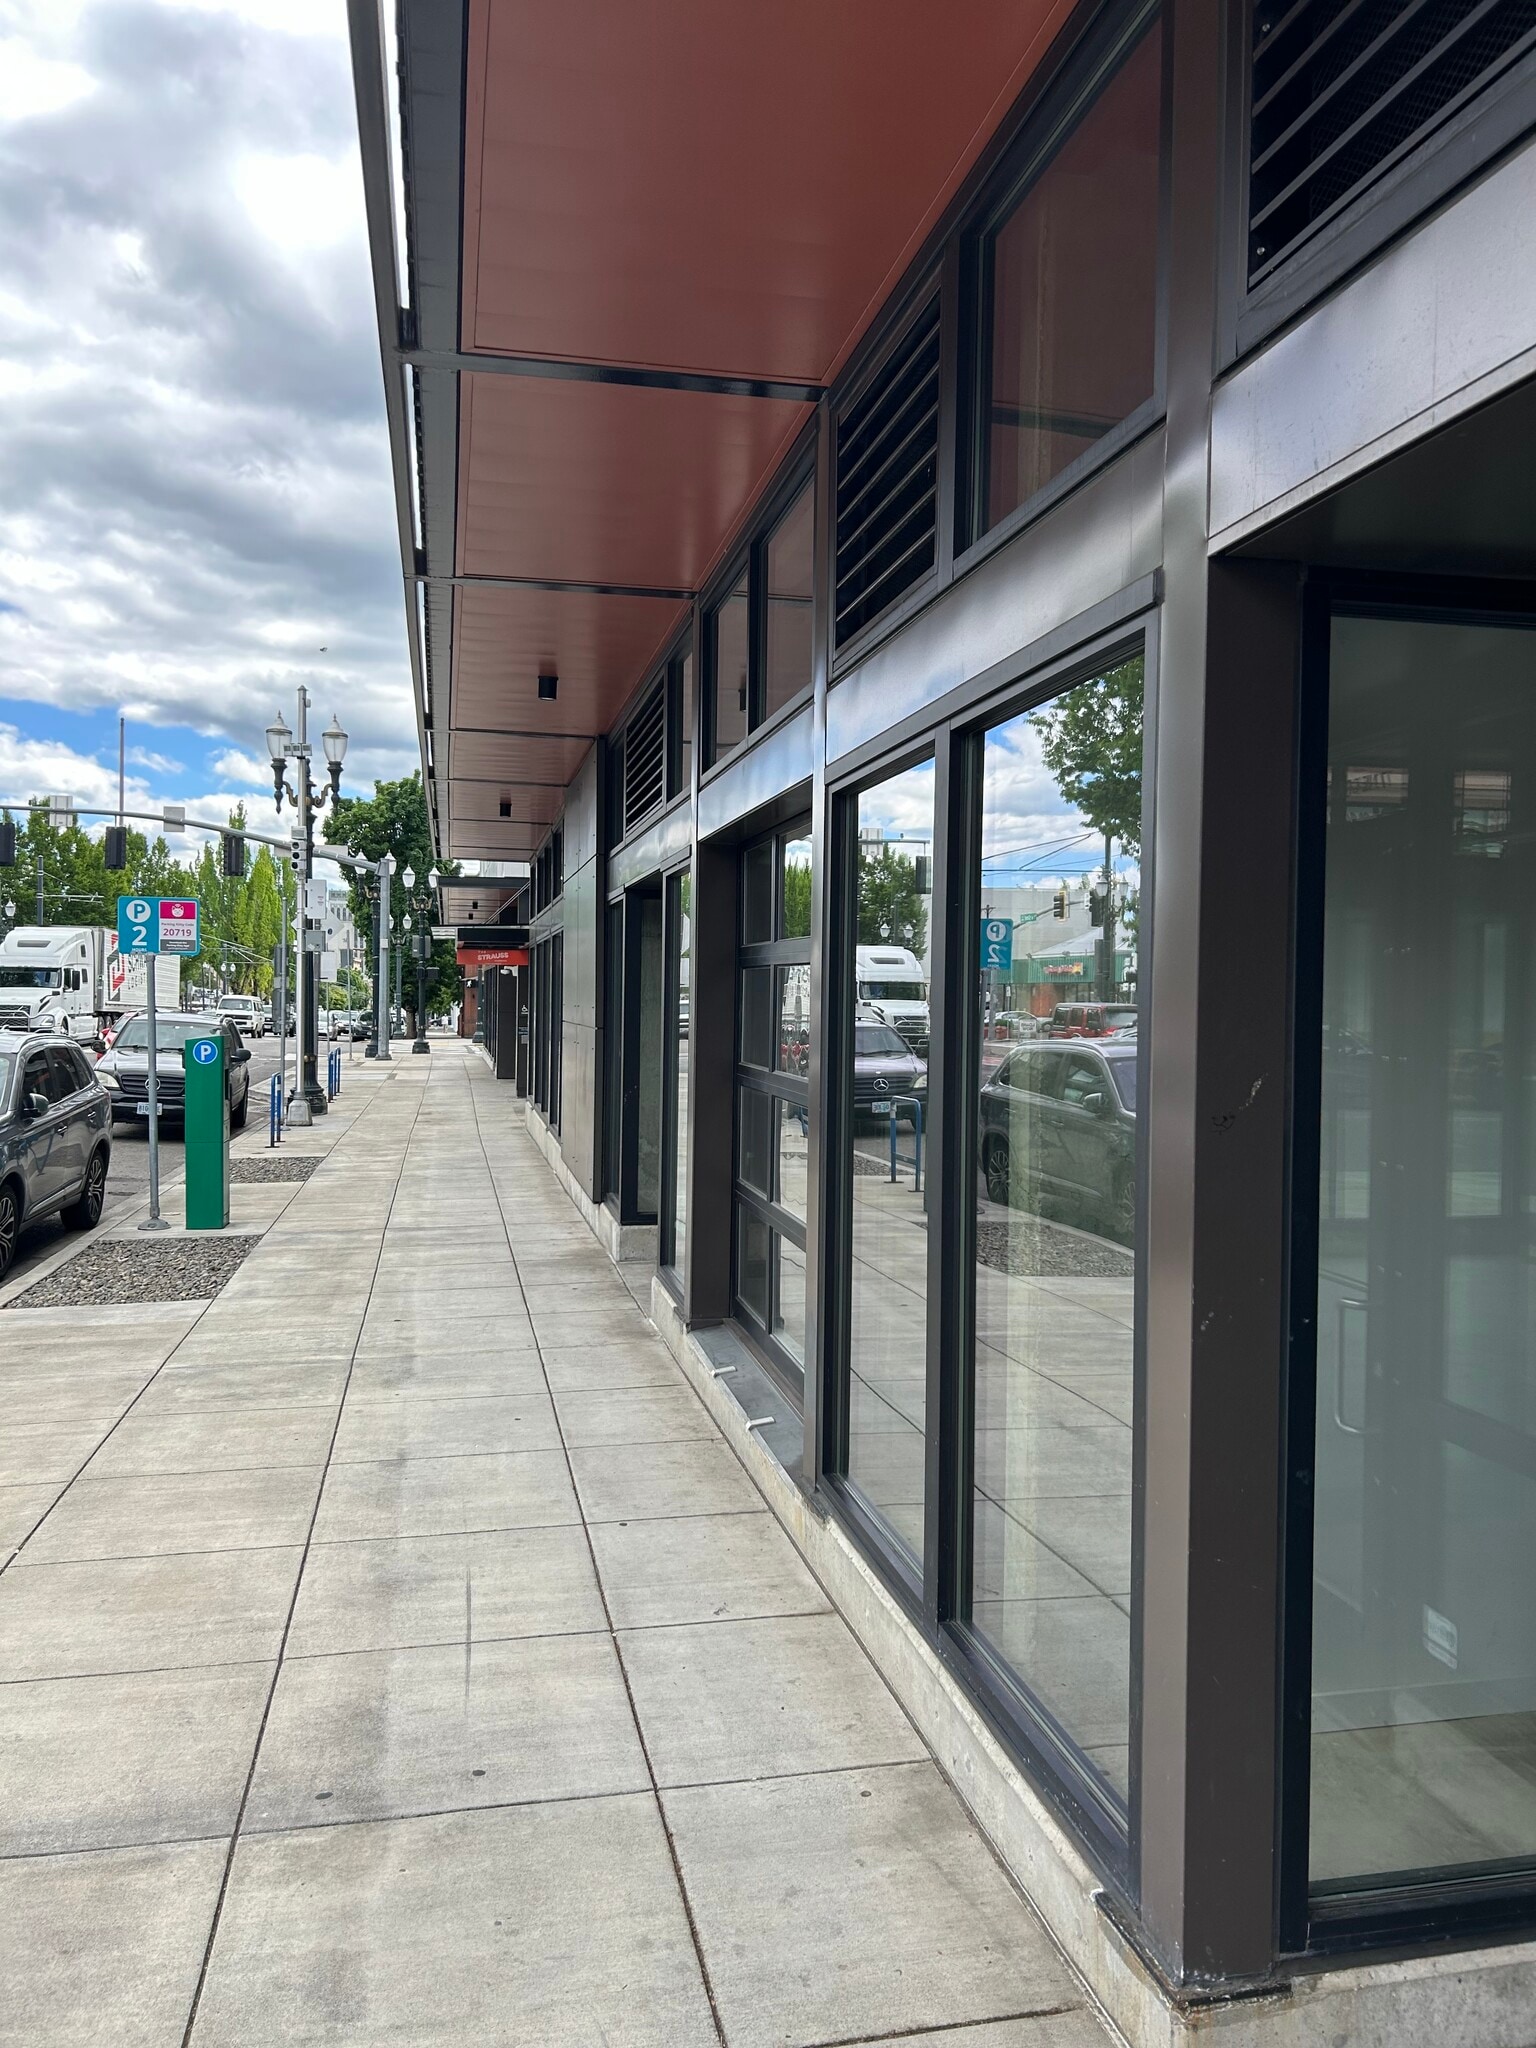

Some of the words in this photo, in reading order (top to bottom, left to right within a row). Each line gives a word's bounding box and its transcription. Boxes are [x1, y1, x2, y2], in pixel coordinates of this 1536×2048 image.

[133, 903, 146, 919] P
[132, 926, 147, 946] 2
[163, 928, 192, 936] 20719
[477, 952, 509, 961] STRAUSS
[200, 1044, 211, 1061] P
